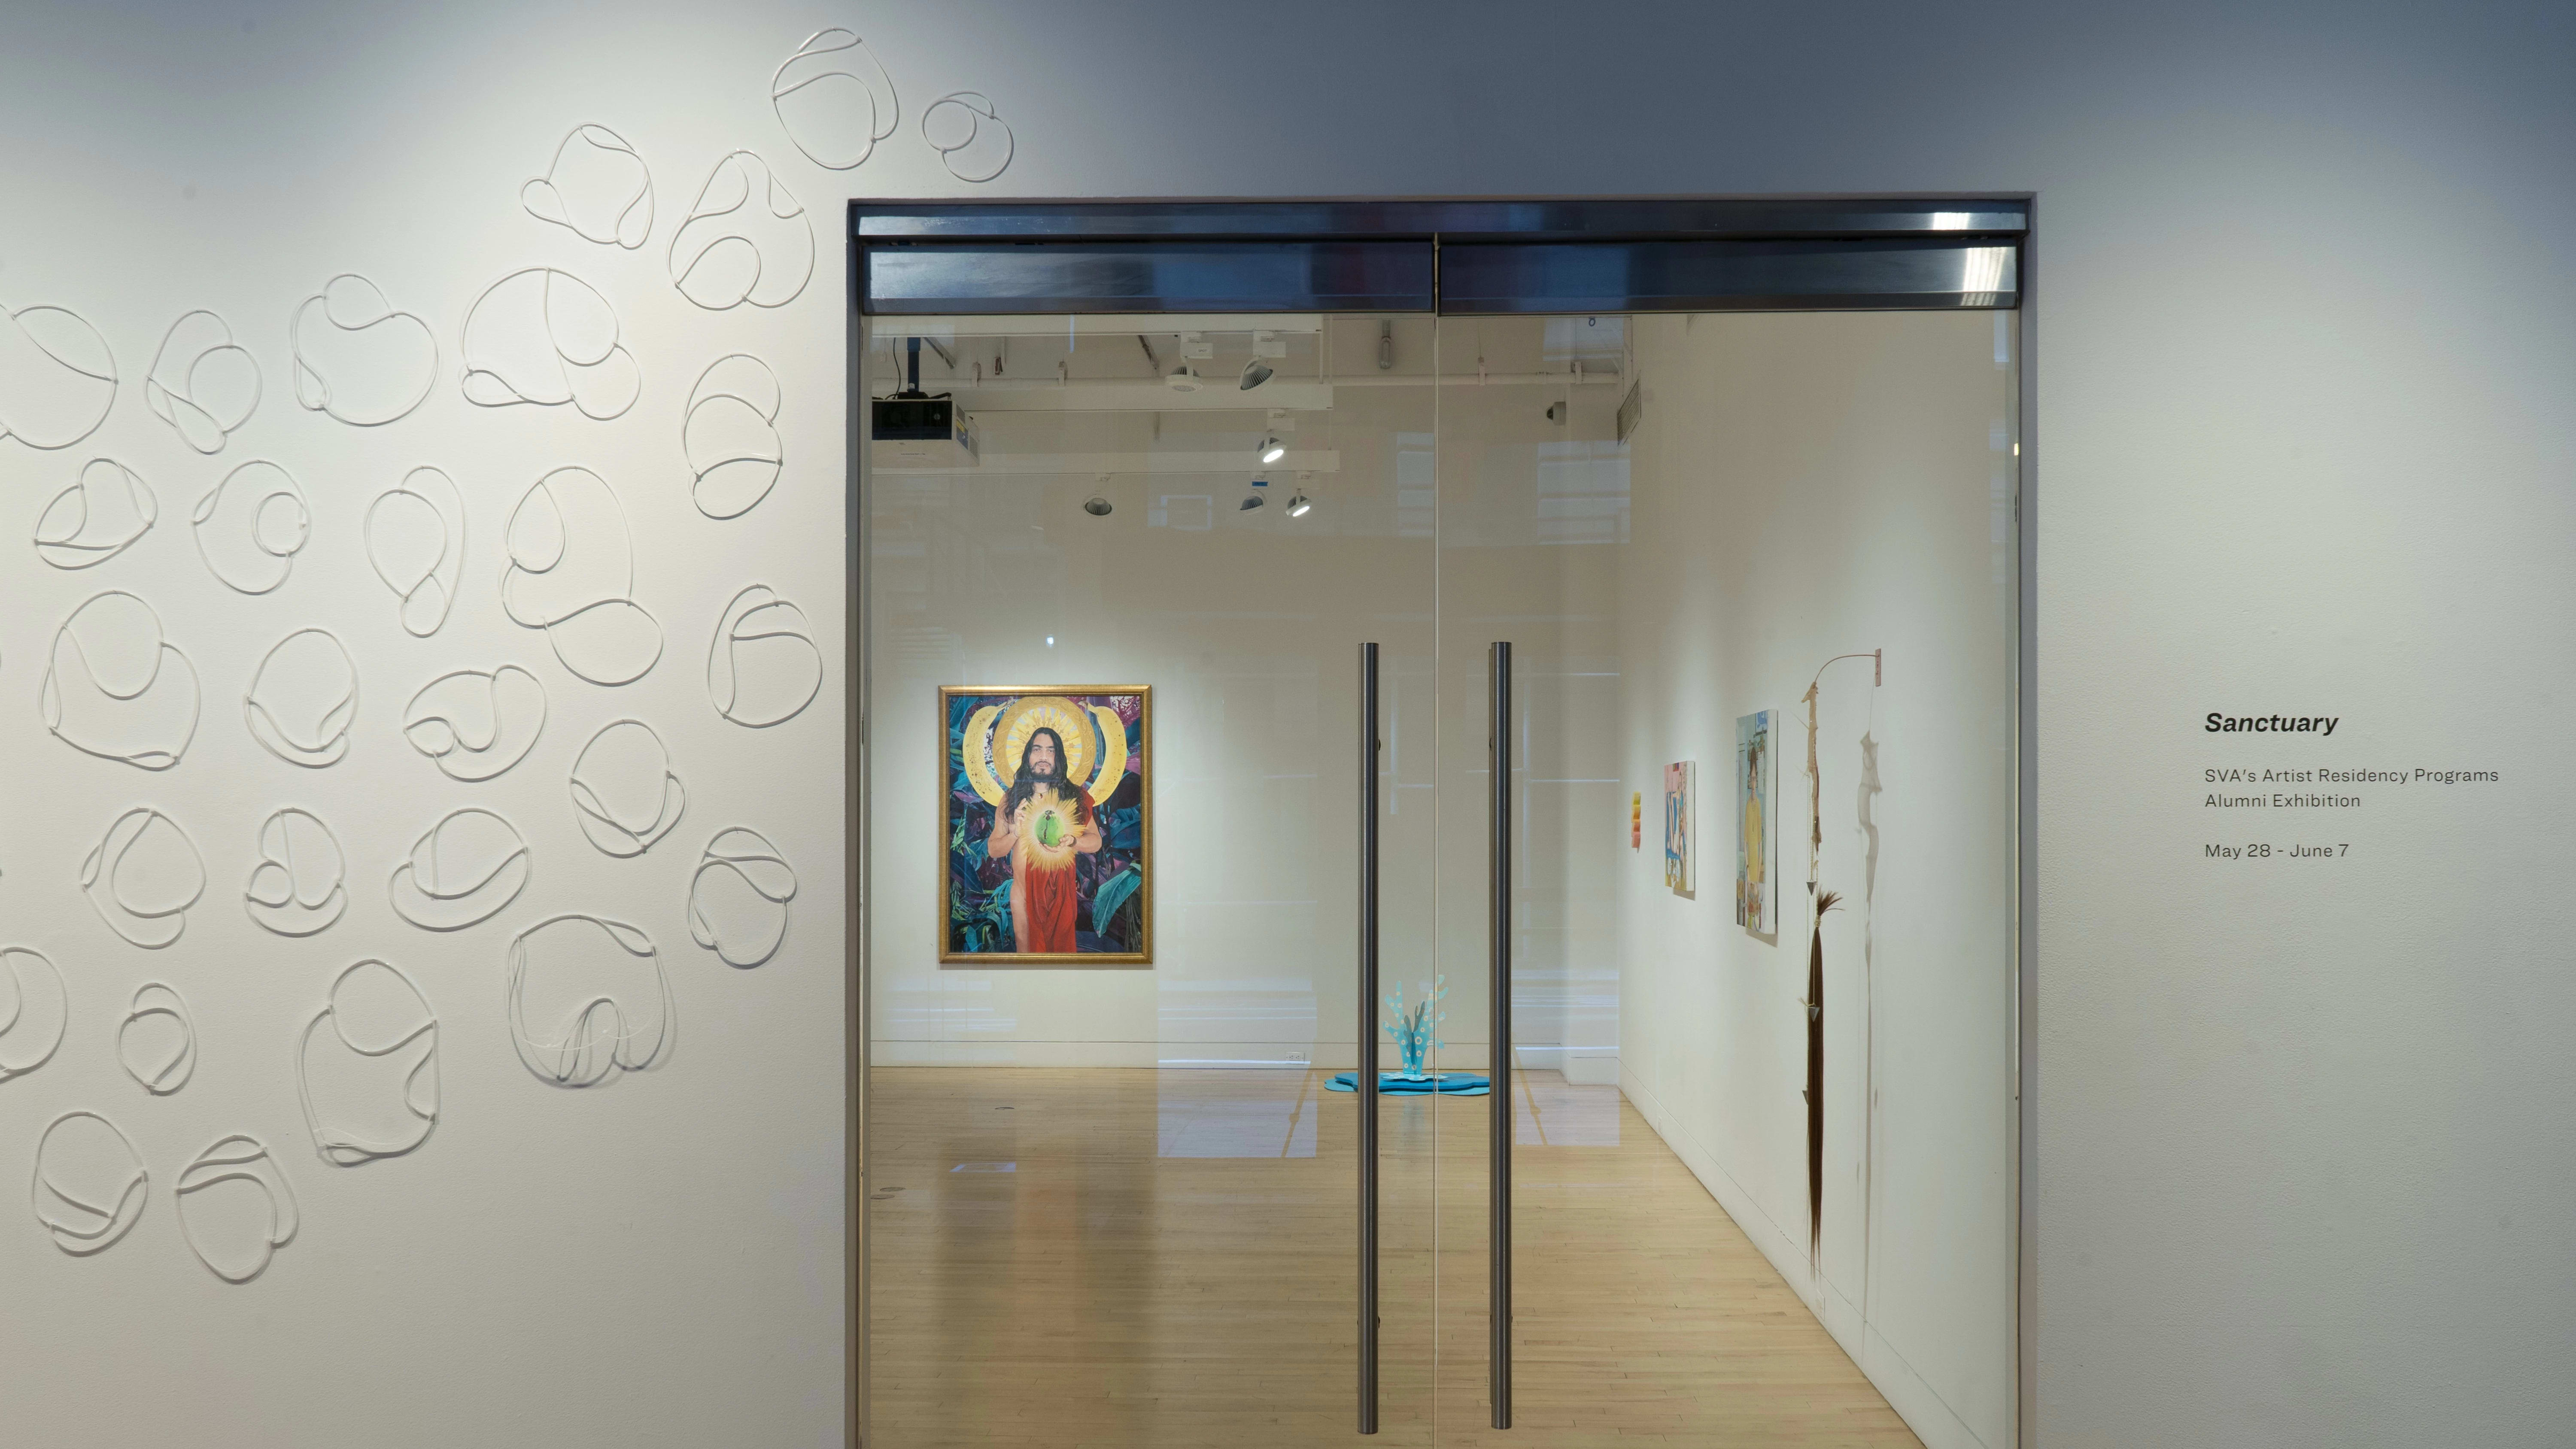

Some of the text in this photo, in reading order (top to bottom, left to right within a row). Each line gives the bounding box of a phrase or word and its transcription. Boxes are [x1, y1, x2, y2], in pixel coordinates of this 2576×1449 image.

[2205, 712, 2339, 736] Sanctuary
[2205, 768, 2499, 785] SVA's Artist Residency Programs
[2205, 793, 2360, 808] Alumni Exhibition
[2205, 844, 2242, 860] May
[2247, 844, 2271, 858] 28
[2289, 844, 2333, 858] June
[2338, 844, 2350, 857] 7
